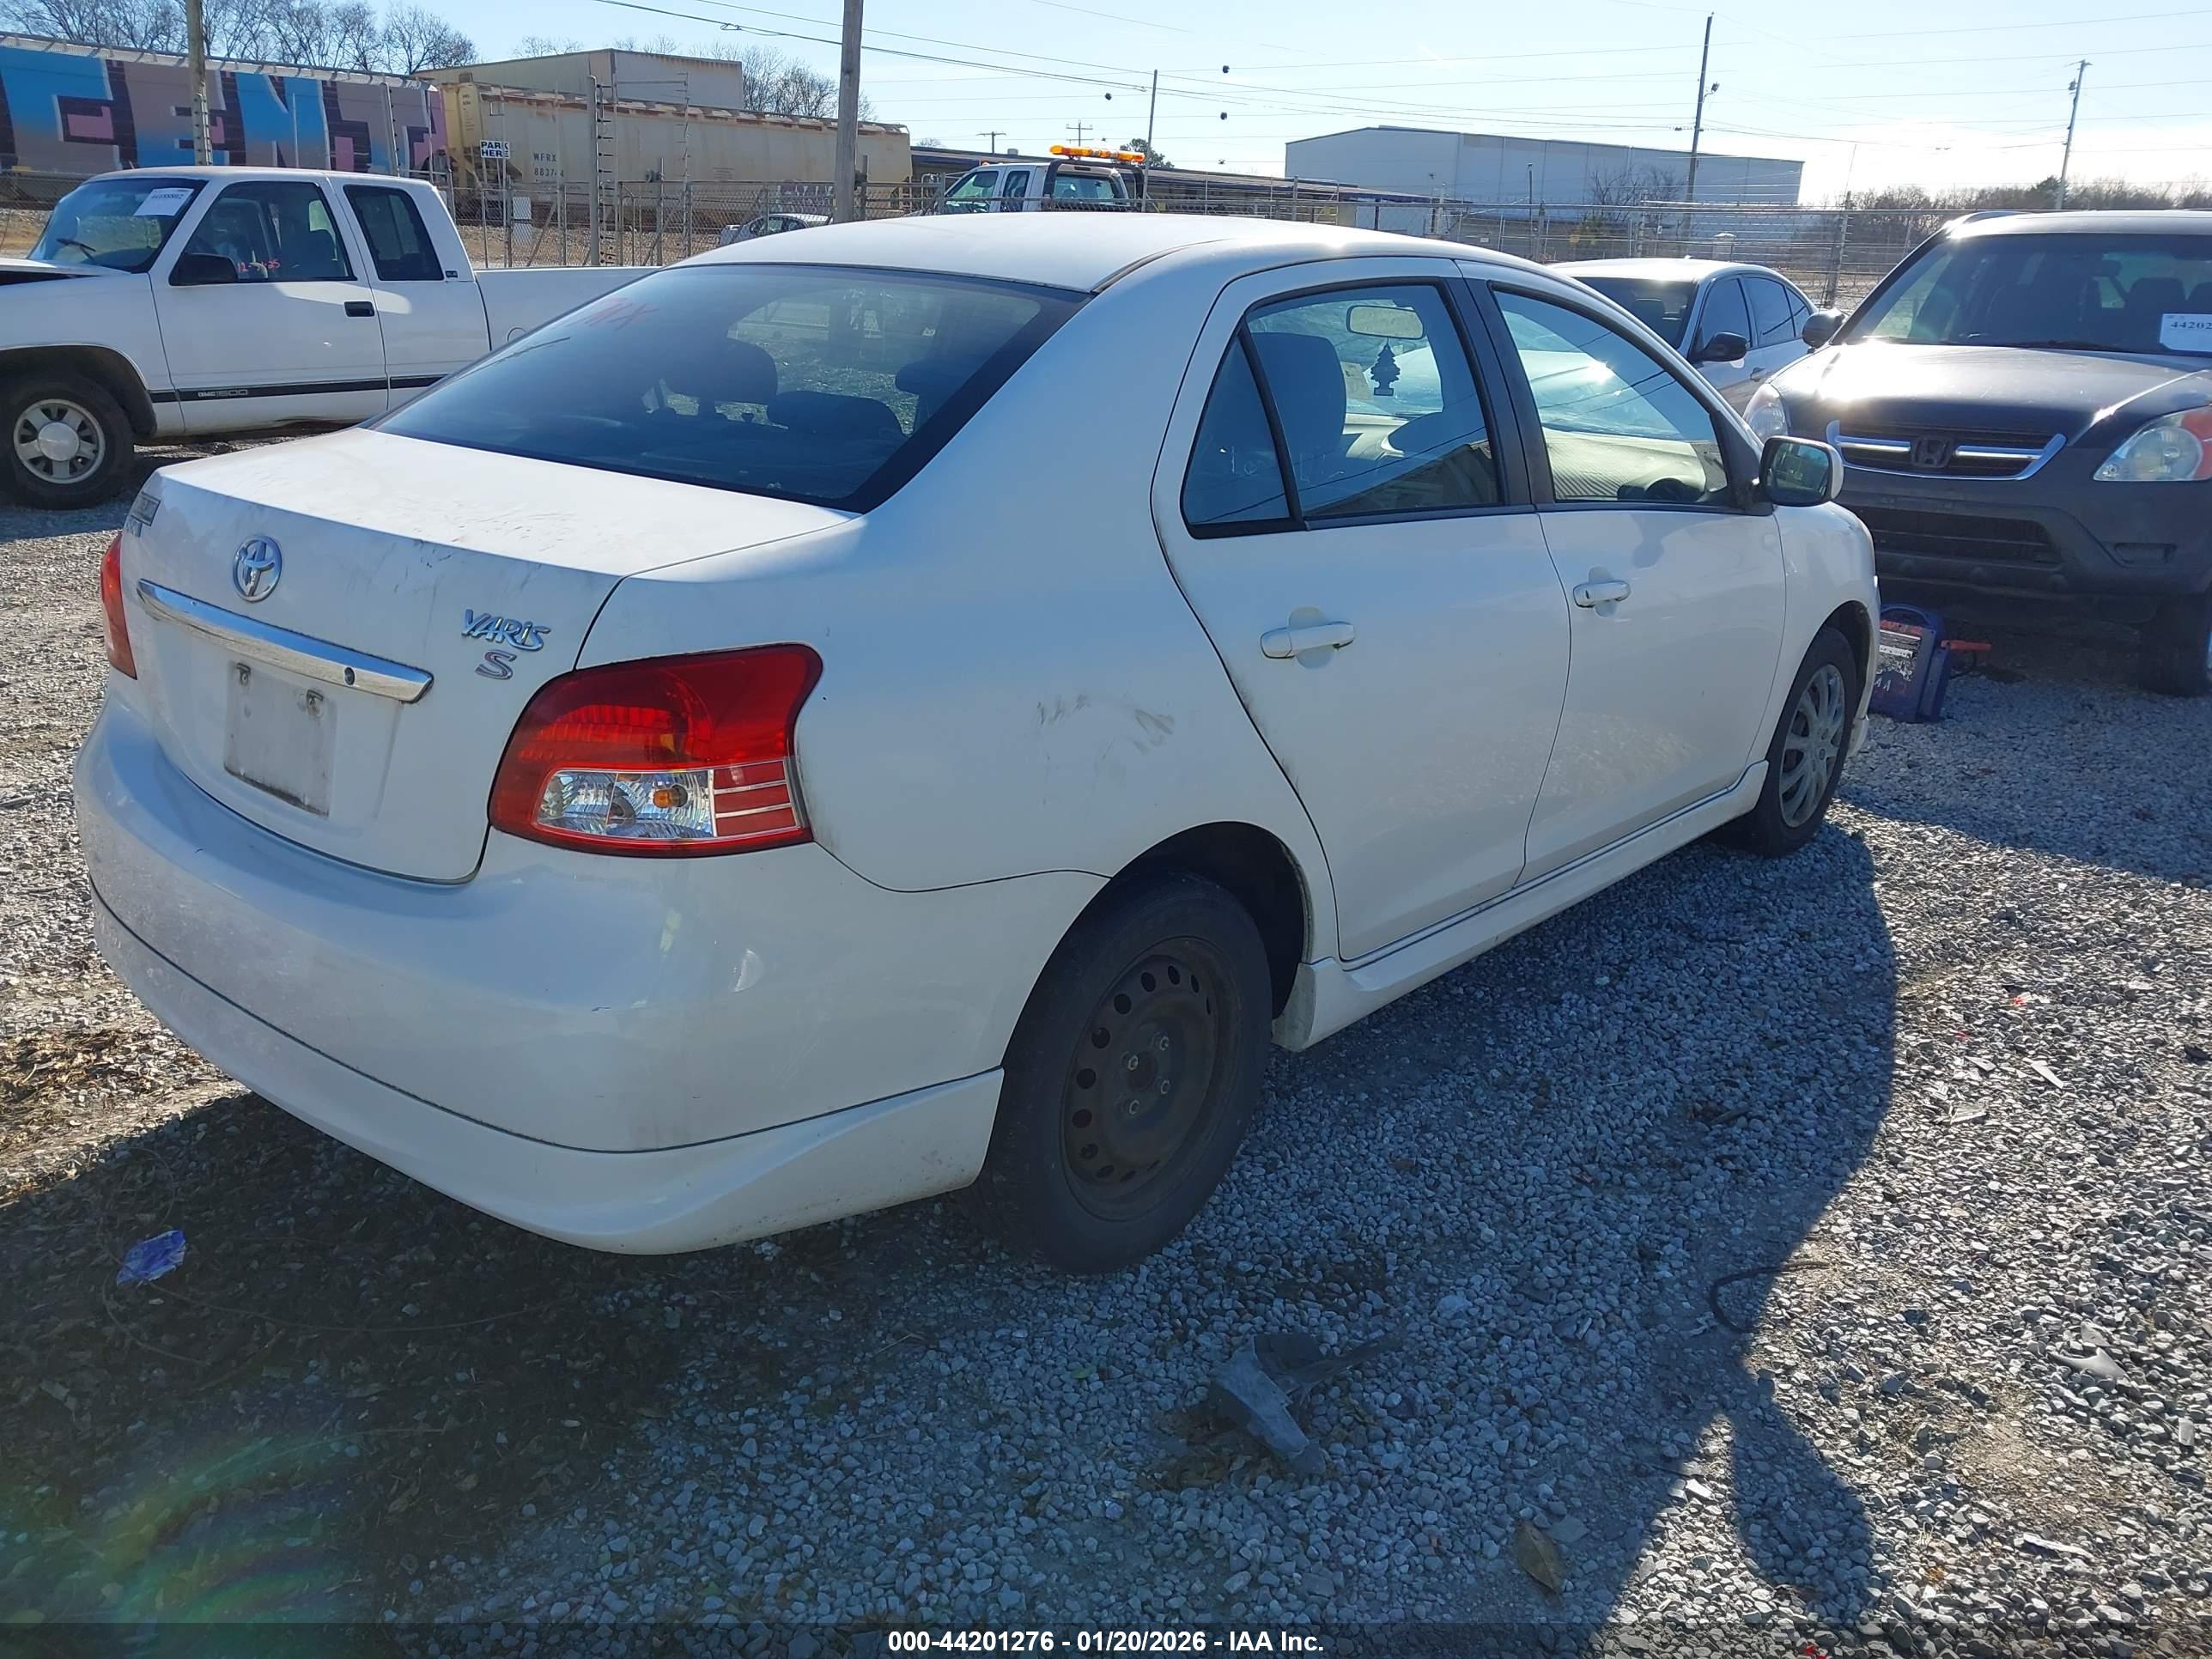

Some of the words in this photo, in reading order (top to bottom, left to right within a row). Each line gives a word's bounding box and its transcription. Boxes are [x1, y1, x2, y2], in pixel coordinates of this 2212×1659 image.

[480, 141, 509, 150] PARK
[481, 149, 509, 158] HERE
[533, 152, 557, 163] WFRX
[474, 650, 517, 680] S
